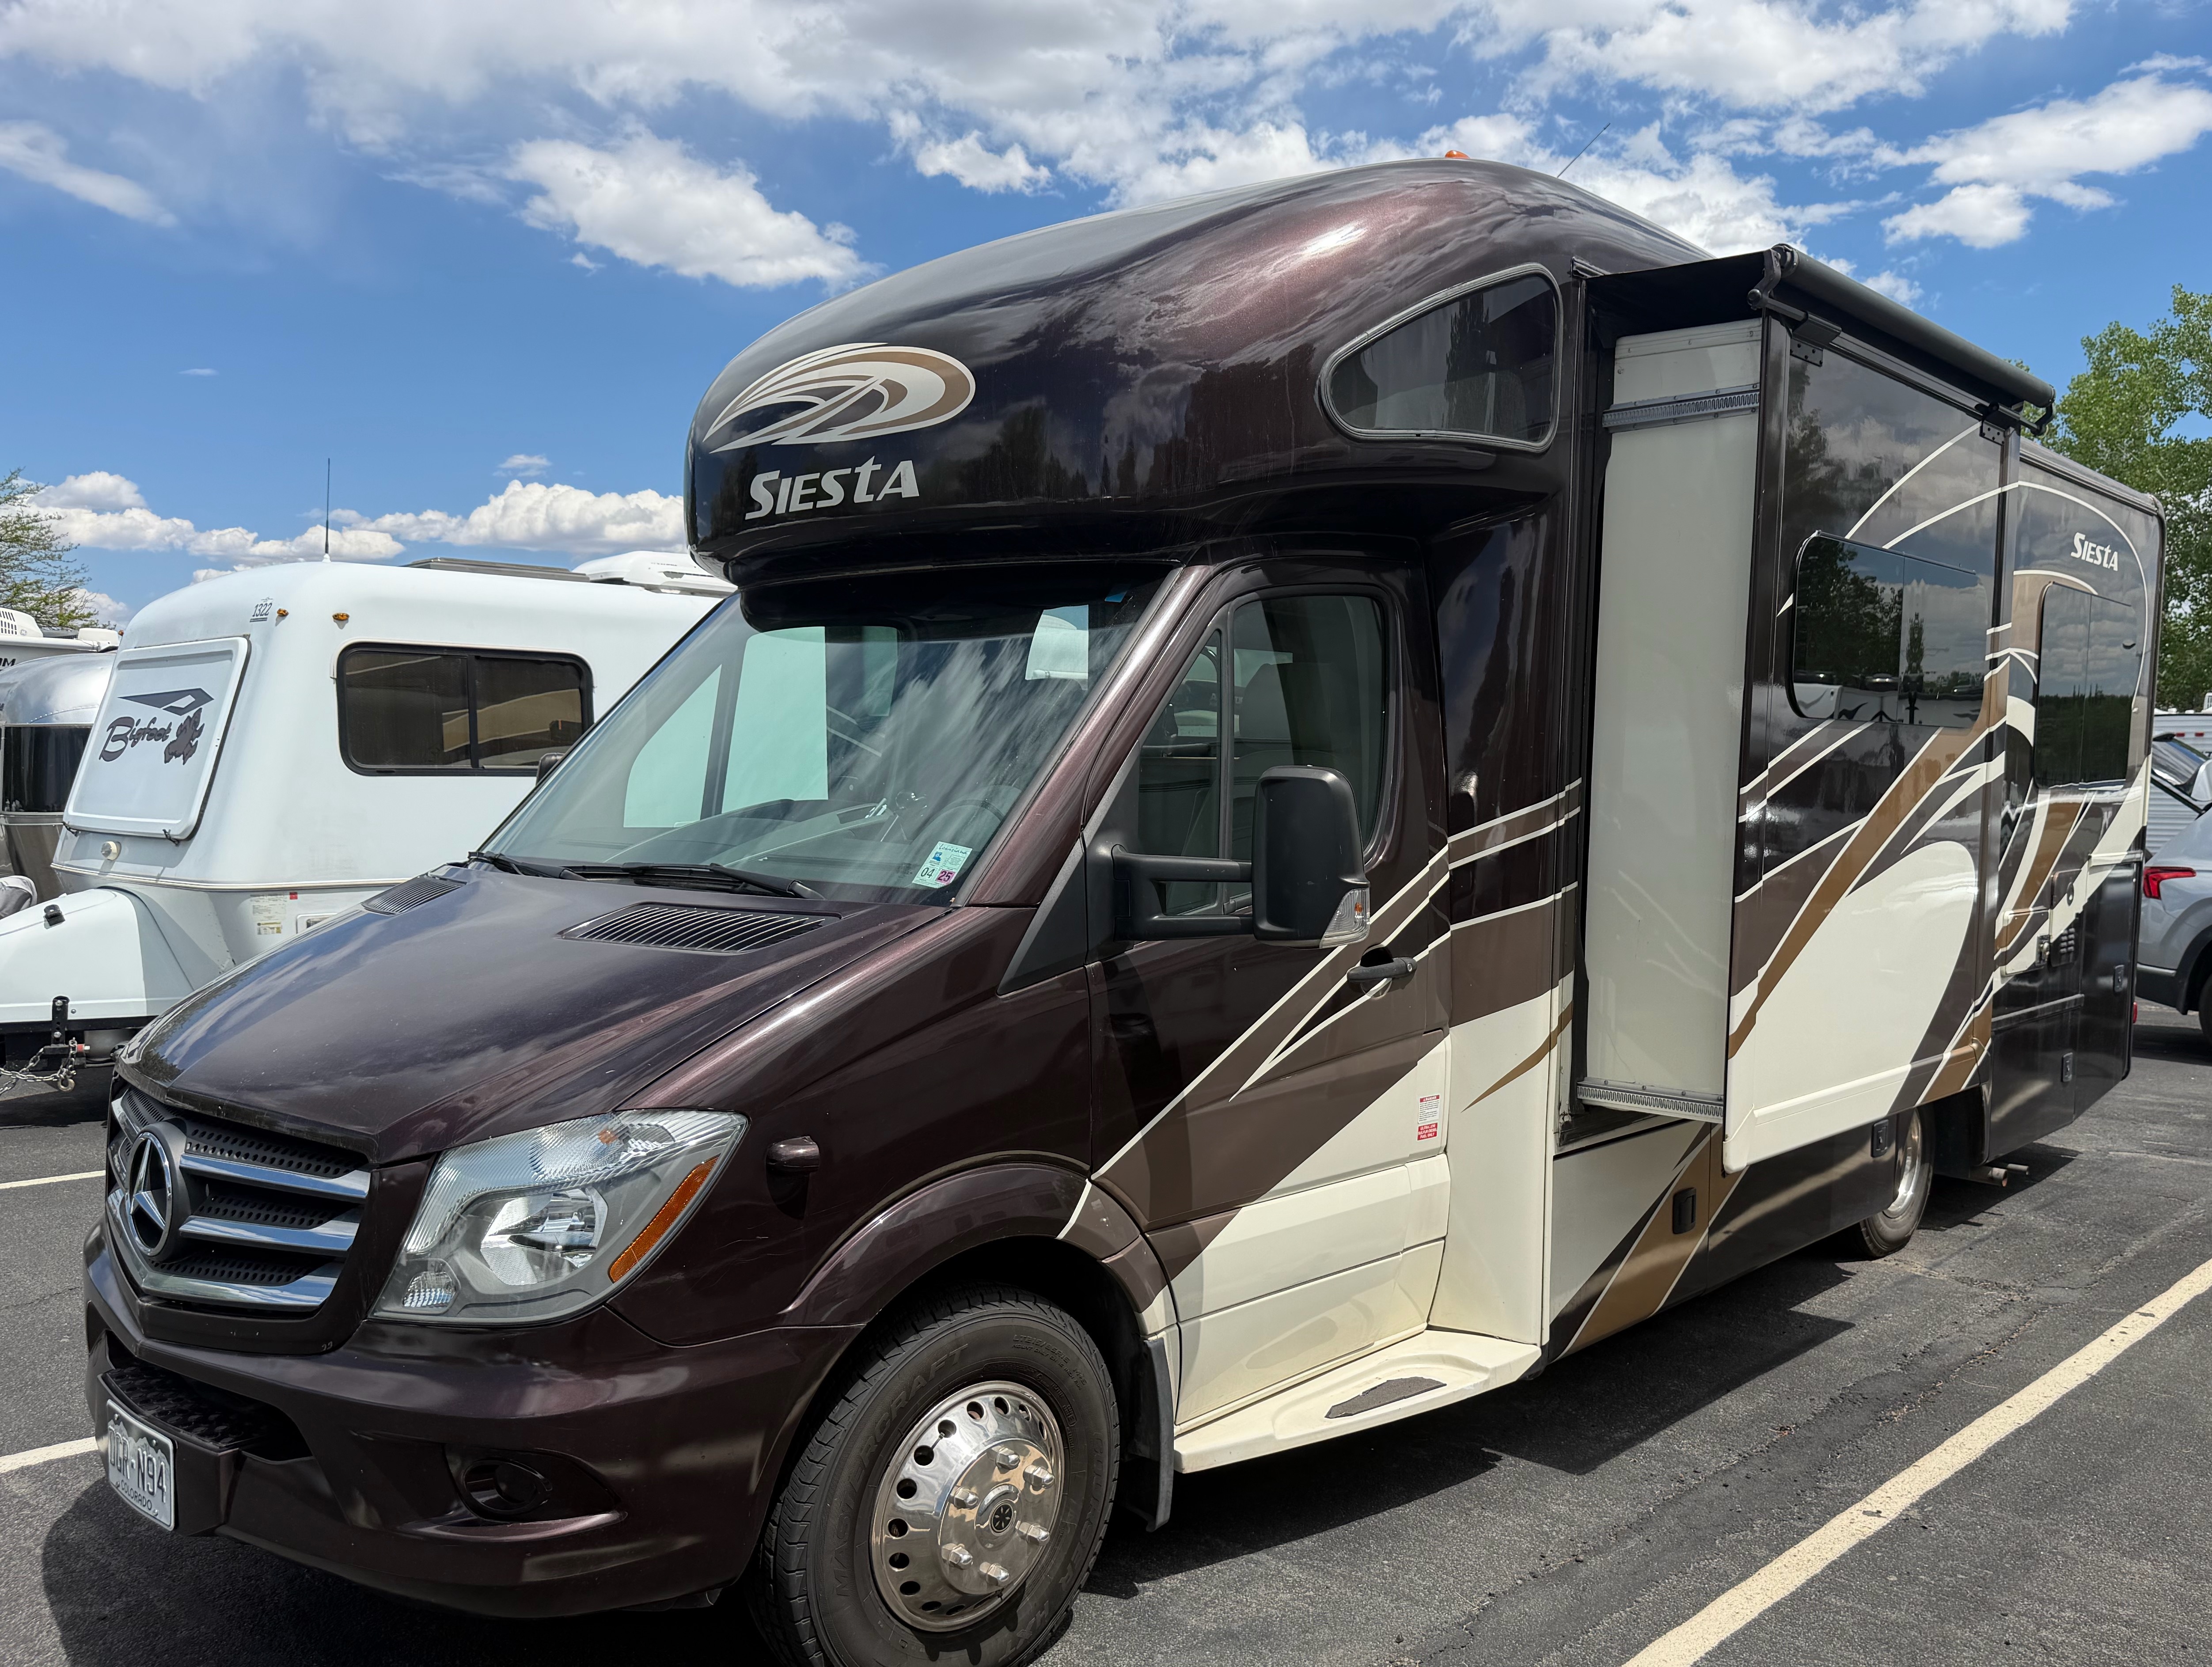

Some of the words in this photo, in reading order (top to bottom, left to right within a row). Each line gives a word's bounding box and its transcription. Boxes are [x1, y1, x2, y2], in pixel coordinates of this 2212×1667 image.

[252, 602, 273, 617] 1322
[99, 716, 172, 762] Bigfoot
[921, 867, 935, 878] 04
[937, 870, 953, 882] 25
[834, 1343, 968, 1597] MASTERCRAFT
[121, 1480, 152, 1511] COLORADO
